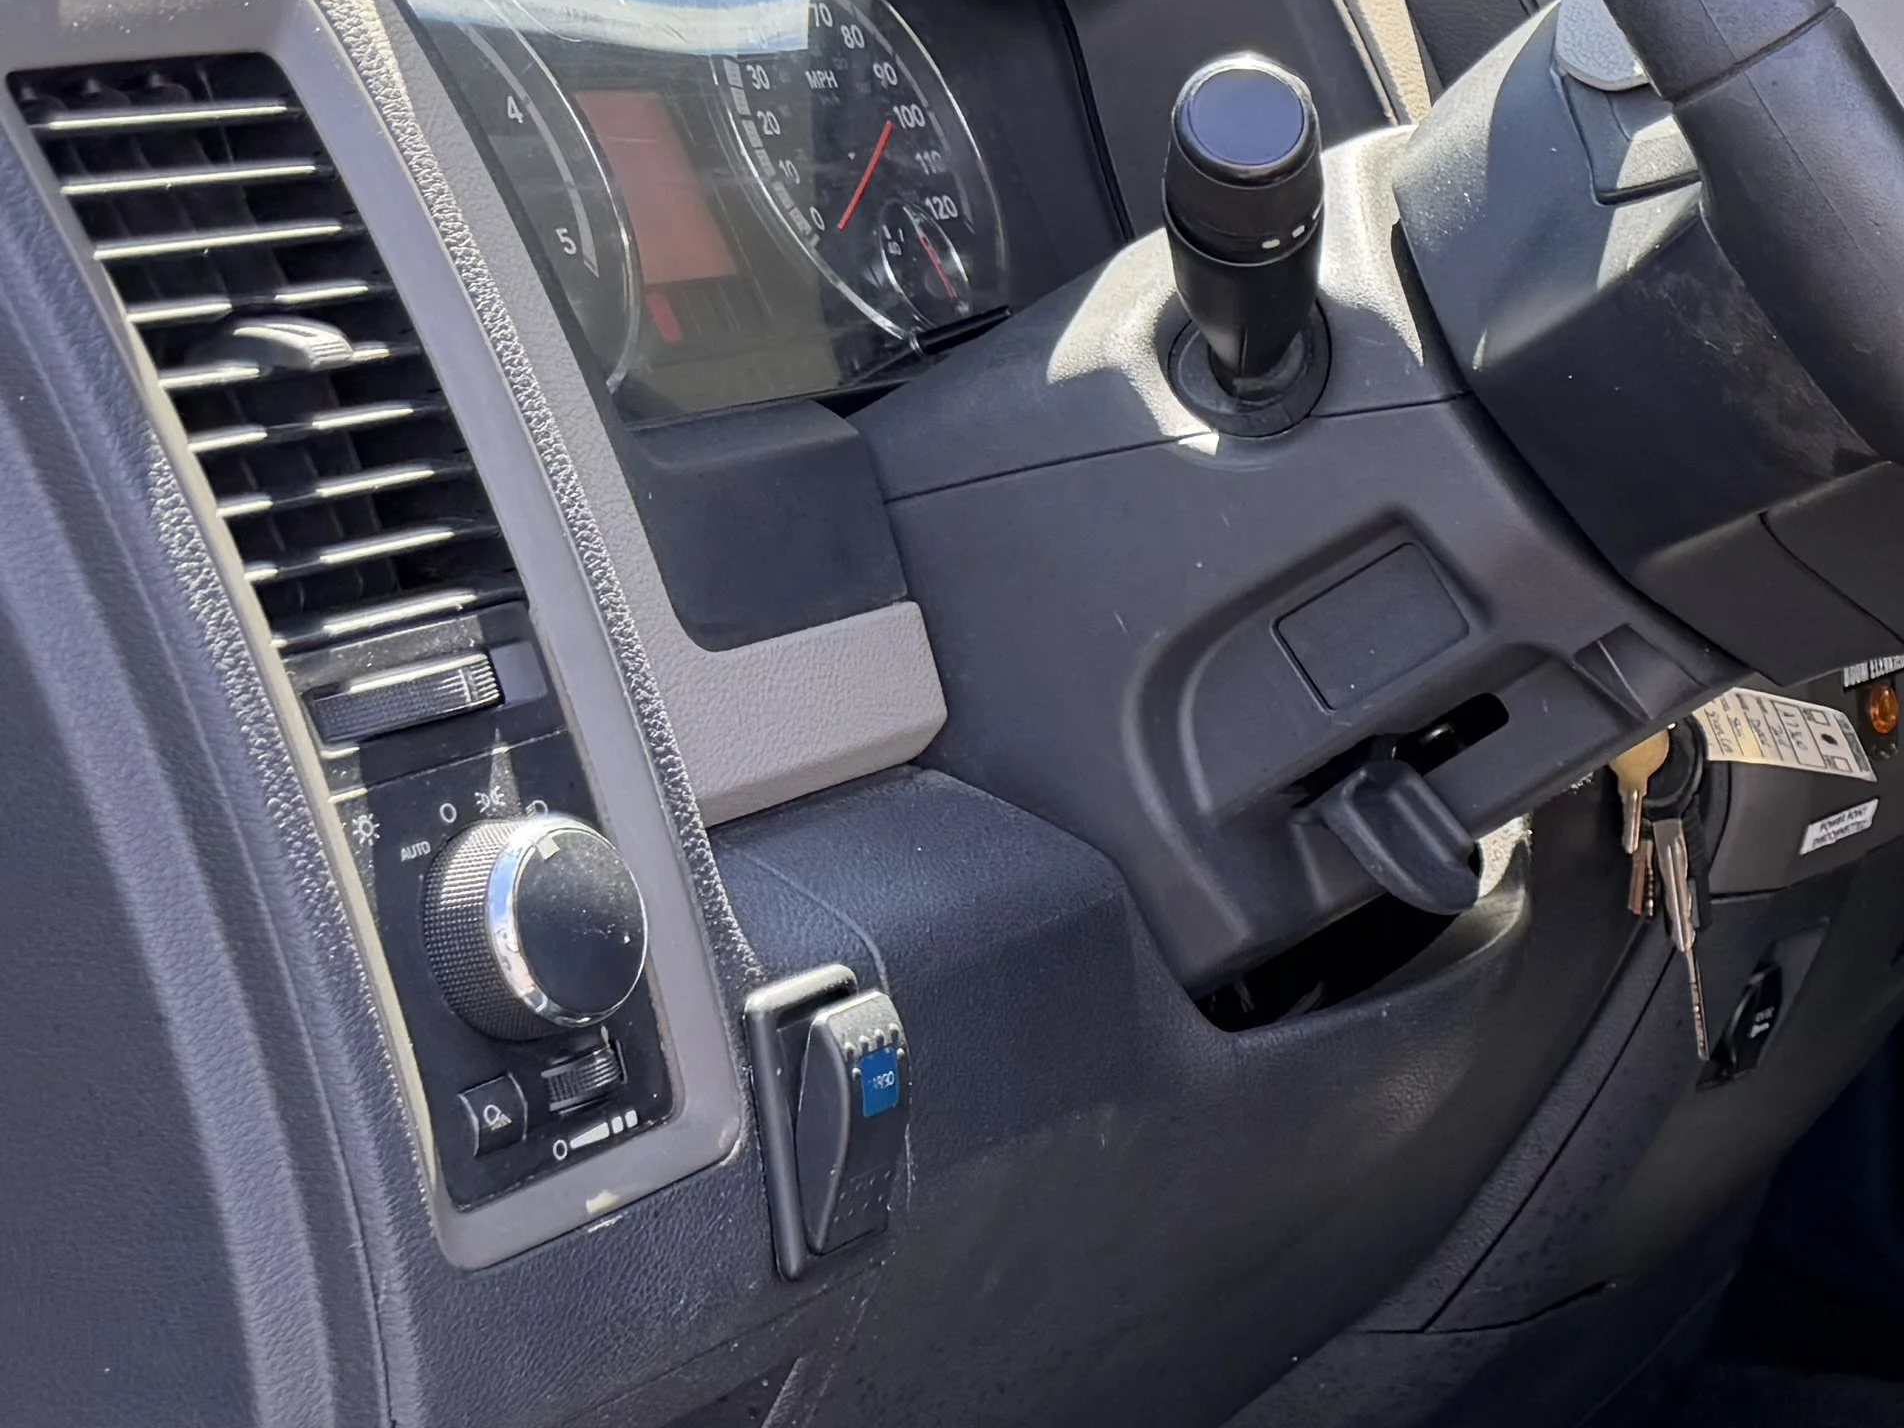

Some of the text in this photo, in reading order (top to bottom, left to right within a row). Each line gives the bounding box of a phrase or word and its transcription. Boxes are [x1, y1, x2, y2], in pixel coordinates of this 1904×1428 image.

[809, 2, 833, 27] 70
[840, 24, 865, 49] 80
[746, 64, 771, 90] 30
[805, 71, 838, 89] MPH
[872, 61, 898, 88] 90
[507, 95, 524, 124] 4
[893, 103, 926, 128] 100
[757, 110, 781, 136] 20
[779, 159, 800, 185] 10
[915, 150, 946, 175] 110
[810, 206, 825, 231] 0
[925, 194, 958, 220] 120
[555, 227, 577, 255] 5
[401, 840, 431, 862] AUTO
